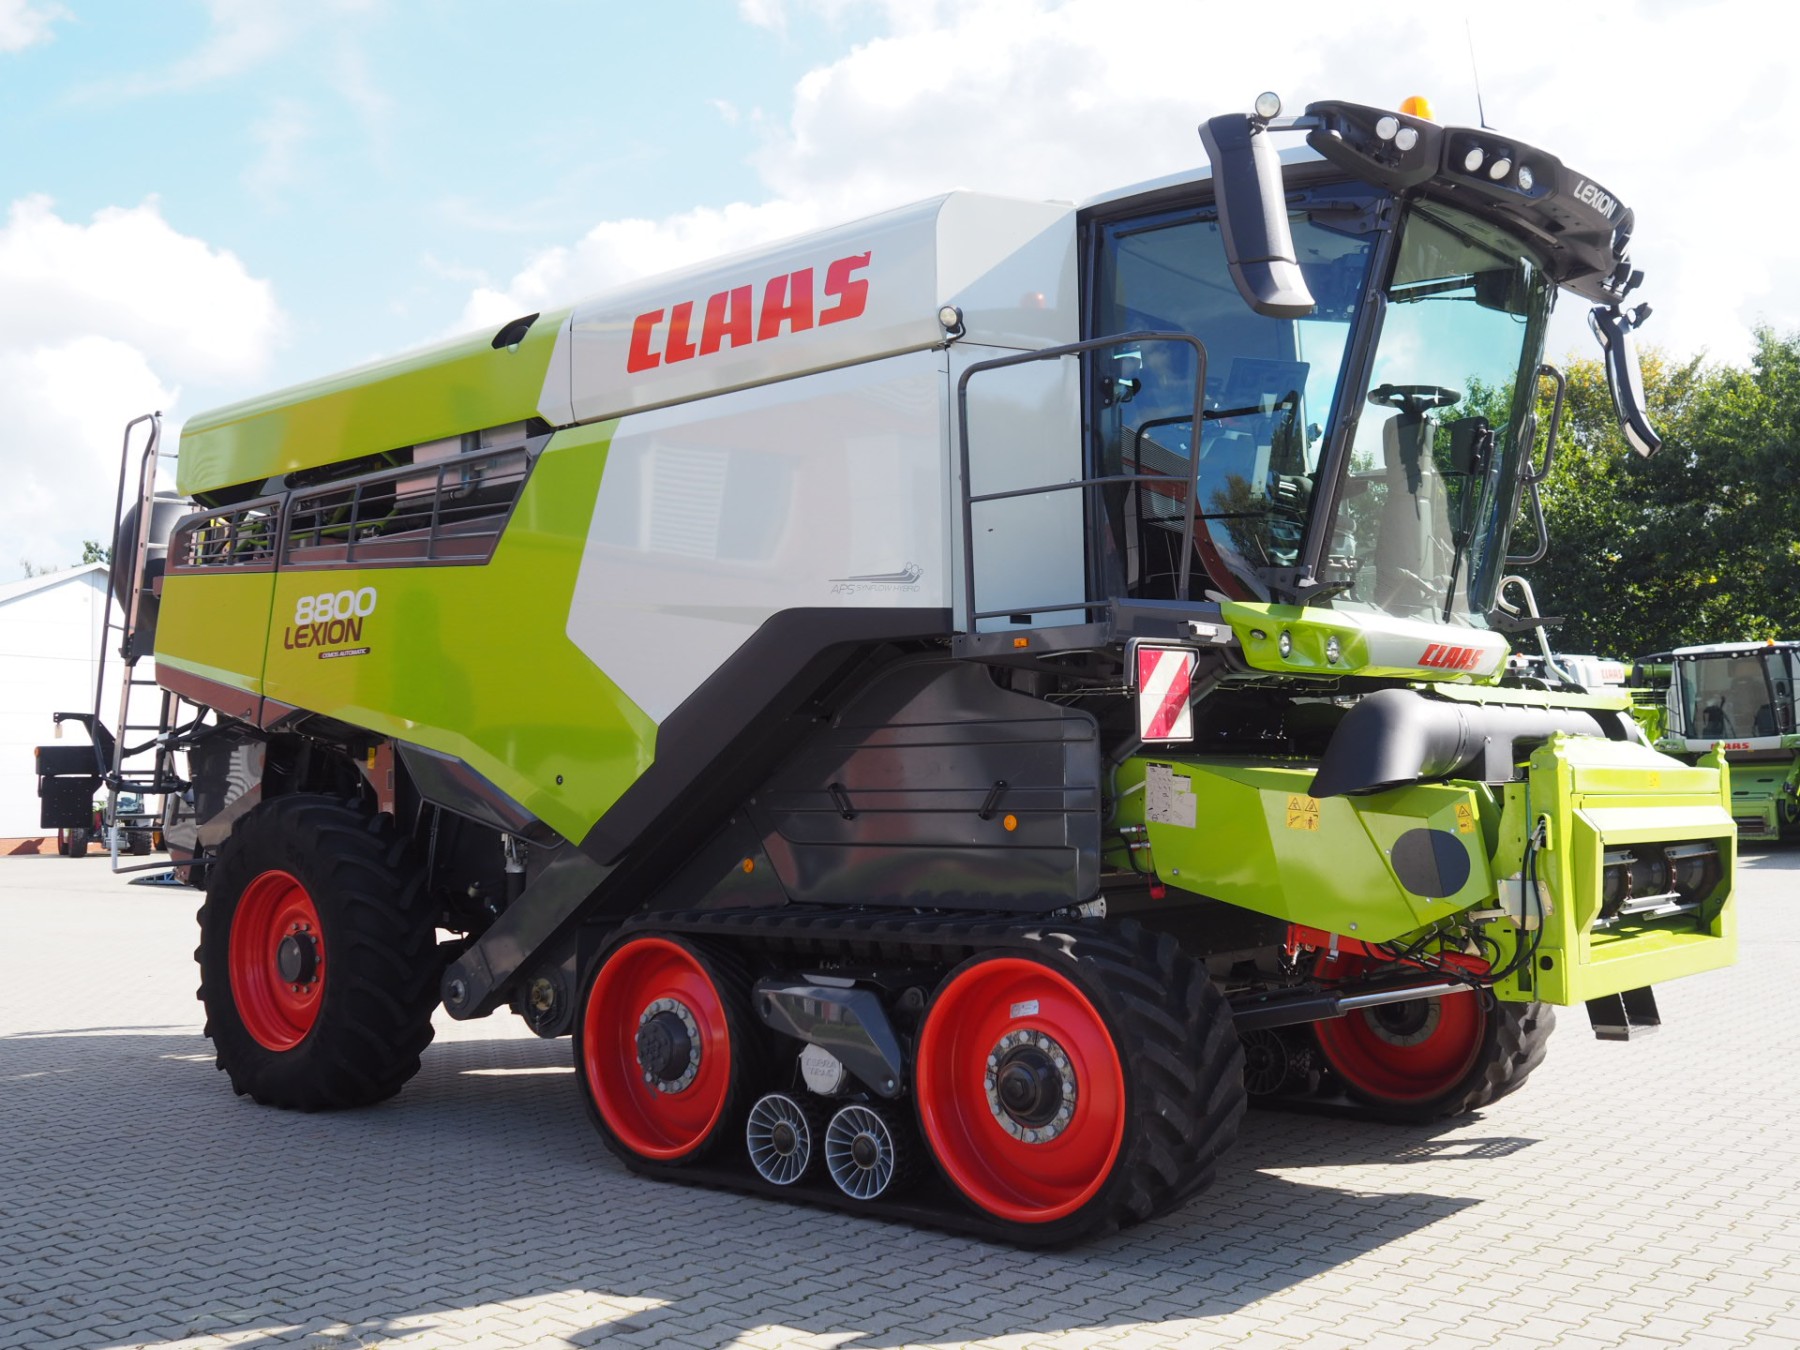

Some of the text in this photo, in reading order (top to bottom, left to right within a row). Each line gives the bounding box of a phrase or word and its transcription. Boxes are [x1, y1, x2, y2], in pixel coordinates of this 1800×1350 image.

[1573, 180, 1618, 219] LEXION
[627, 251, 872, 374] CLAAS
[294, 586, 378, 626] 8800
[830, 584, 855, 595] APS
[284, 616, 363, 650] LEXION
[1417, 643, 1485, 671] CLAAS
[1711, 742, 1750, 751] AAS
